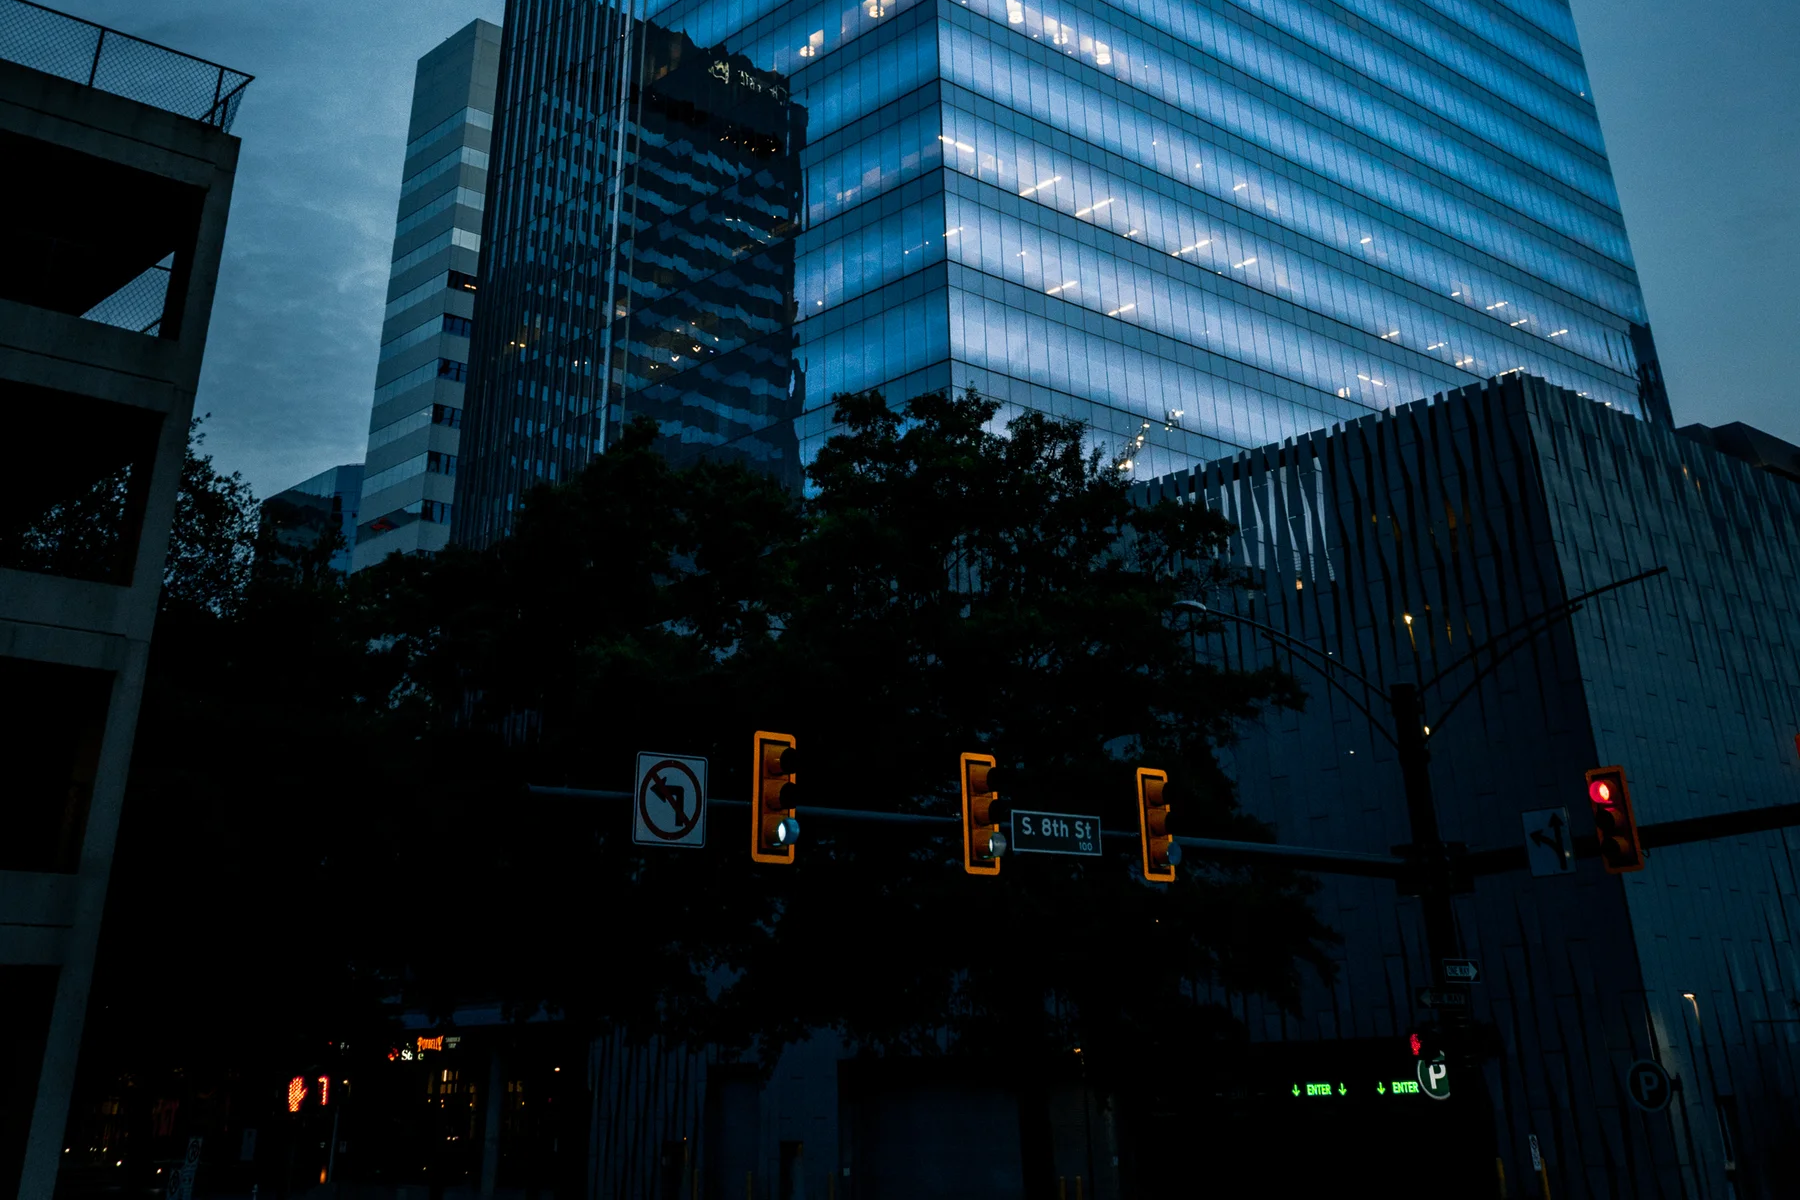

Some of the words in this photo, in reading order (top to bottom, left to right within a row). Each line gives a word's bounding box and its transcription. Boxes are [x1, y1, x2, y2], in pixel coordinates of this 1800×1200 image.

[1021, 816, 1036, 836] S.
[1041, 817, 1069, 838] 8th
[1074, 820, 1092, 840] St
[1078, 841, 1093, 852] 100
[1428, 1064, 1446, 1090] P
[1639, 1071, 1659, 1100] P
[1306, 1083, 1332, 1096] ENTER
[1392, 1081, 1420, 1095] ENTER
